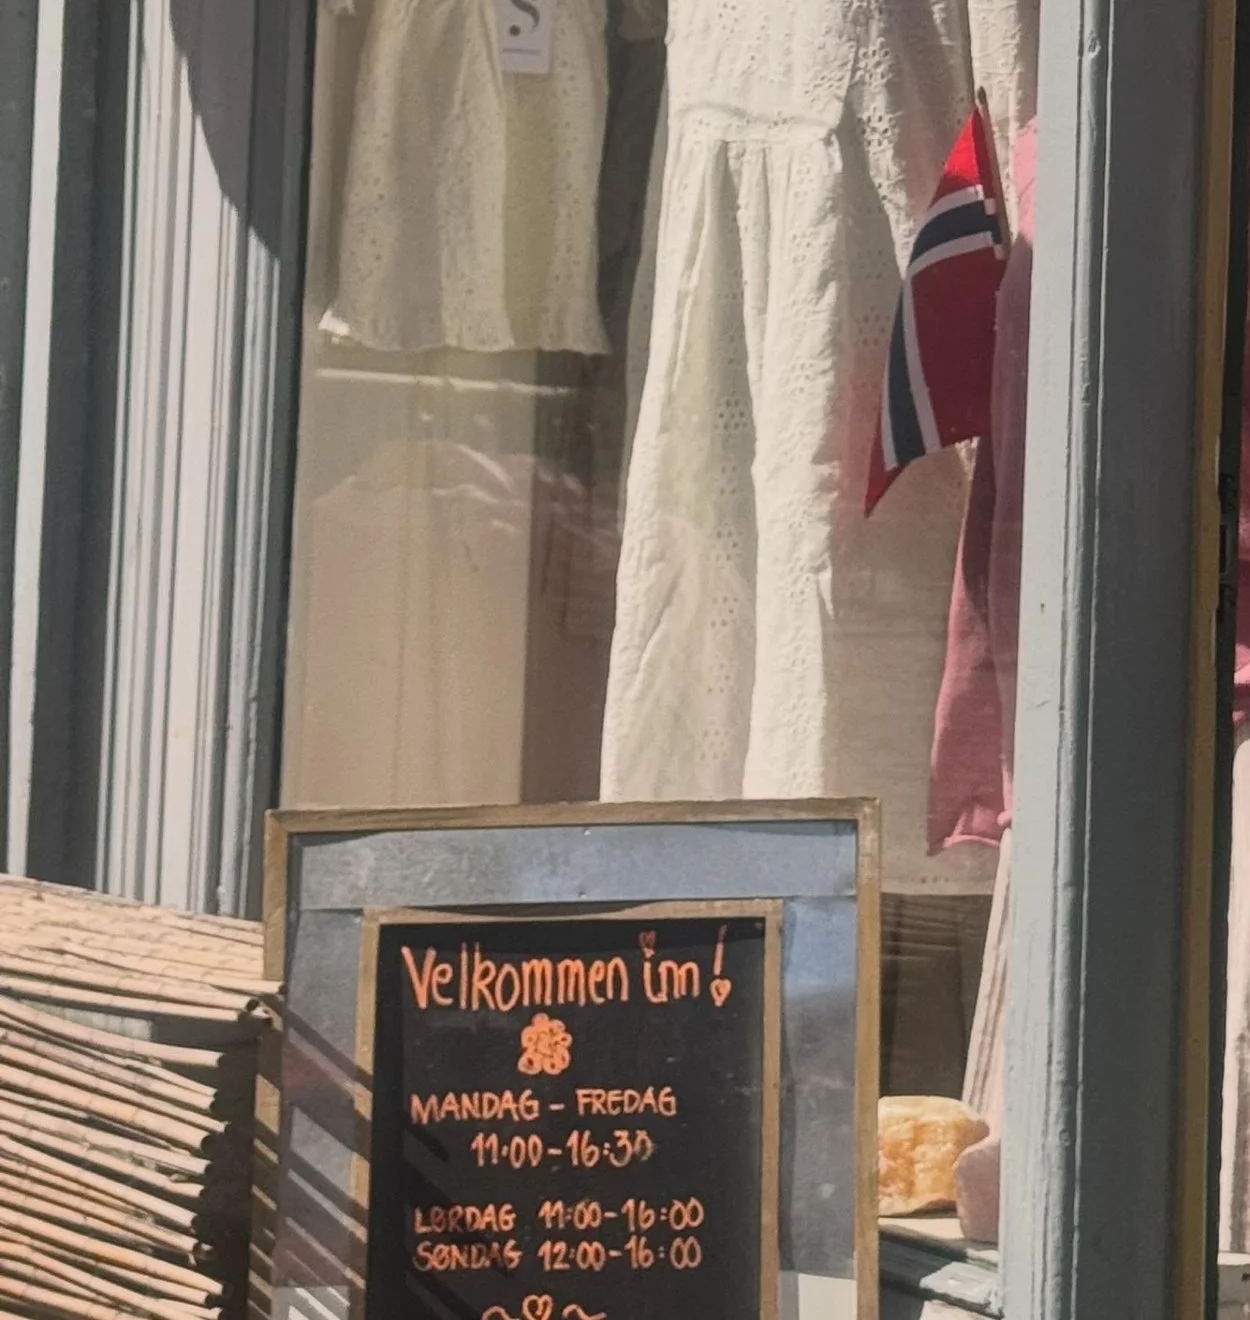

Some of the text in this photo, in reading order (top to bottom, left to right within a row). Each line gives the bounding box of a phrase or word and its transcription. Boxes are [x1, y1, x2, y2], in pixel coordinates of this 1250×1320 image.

[401, 941, 629, 1012] Velkommen
[410, 1088, 540, 1125] MANDAG
[576, 1086, 678, 1117] FREDAG
[413, 1202, 517, 1233] LØRDAG
[412, 1239, 523, 1271] SØNDAG
